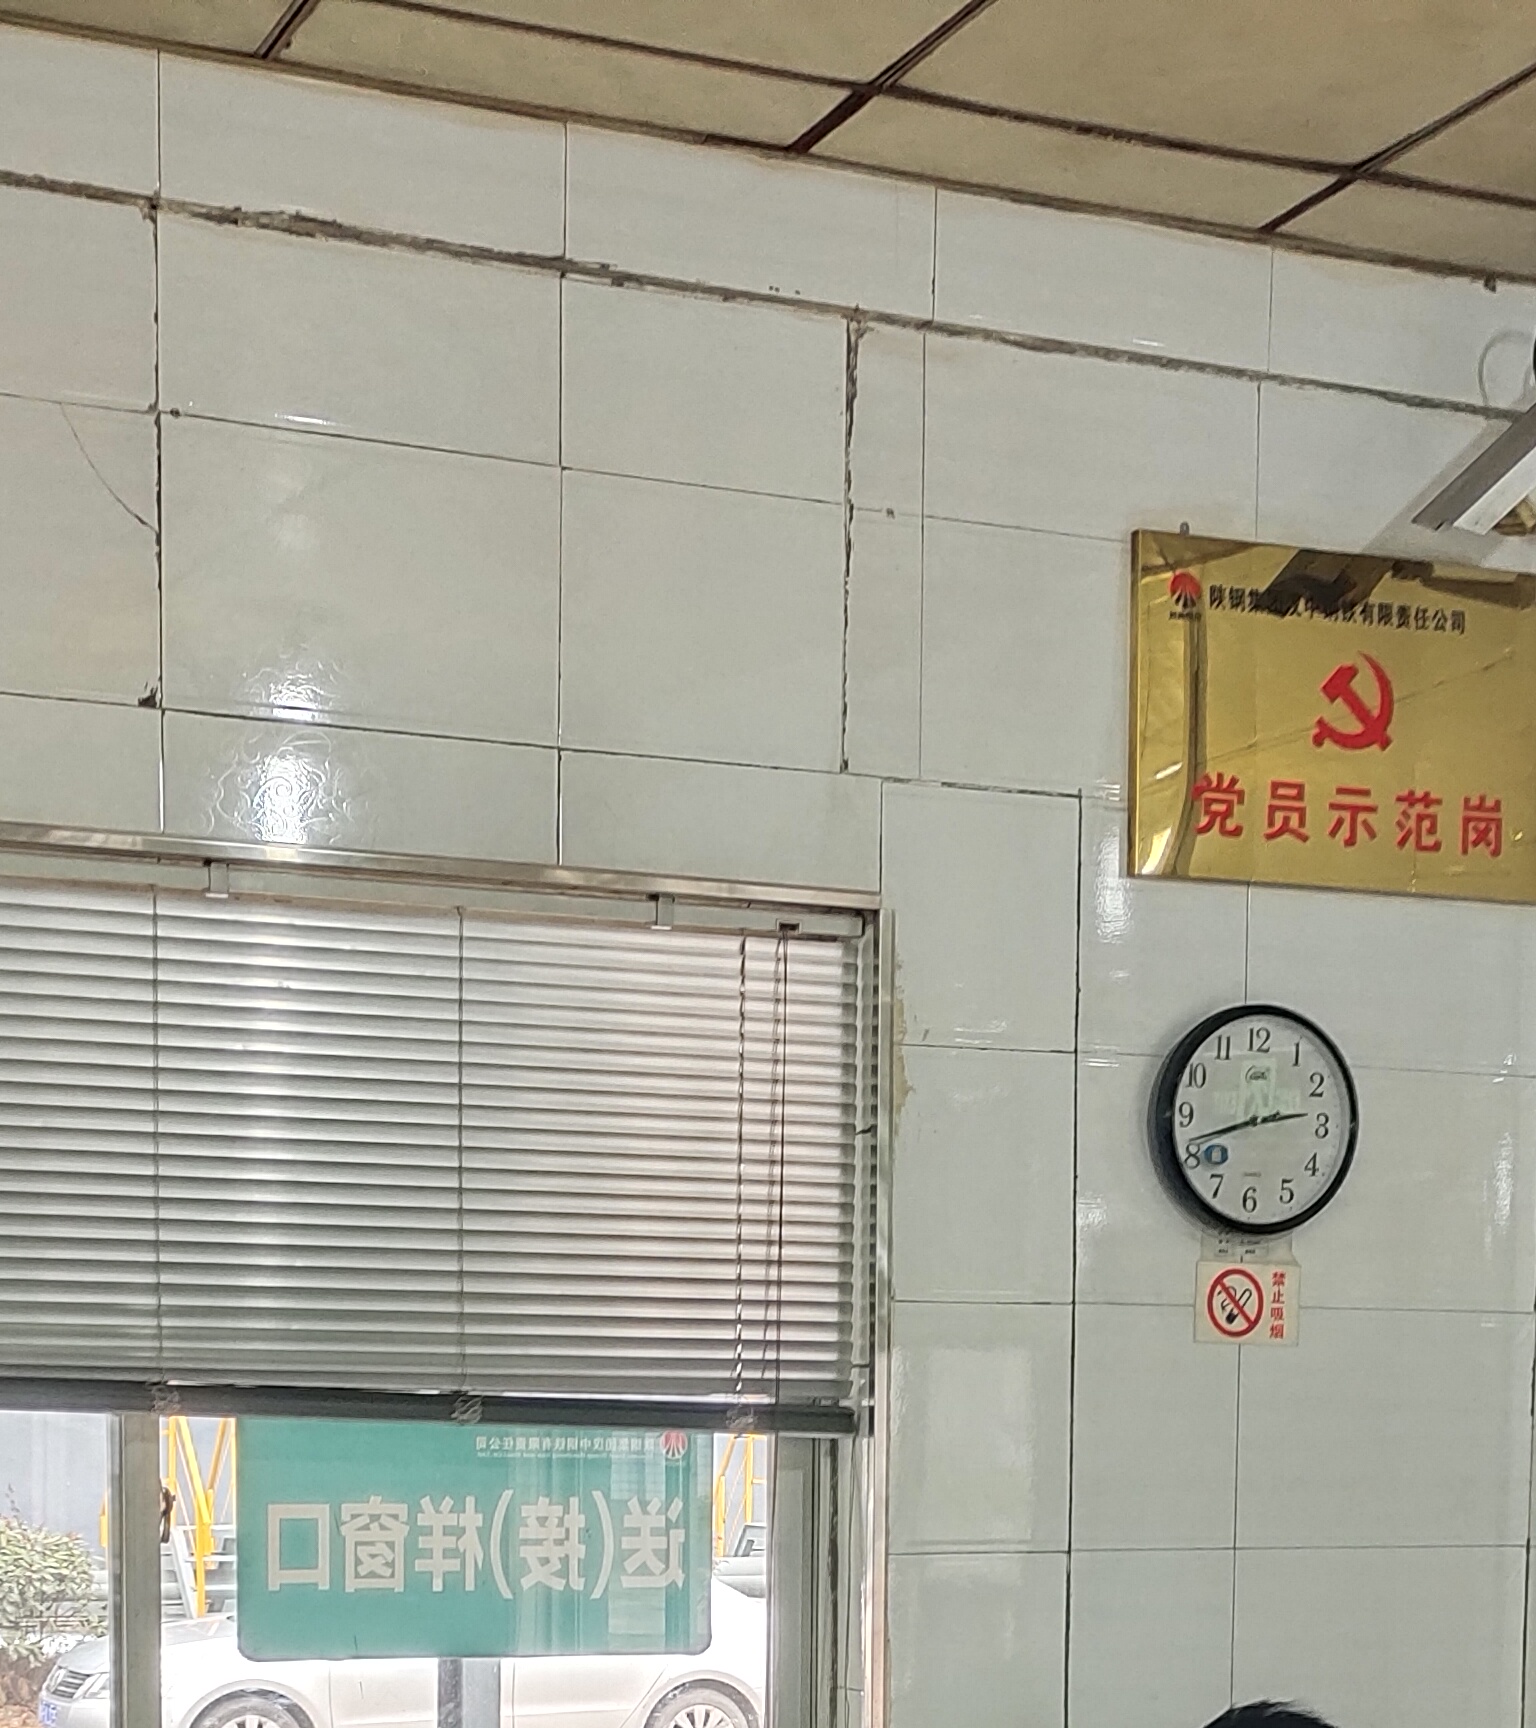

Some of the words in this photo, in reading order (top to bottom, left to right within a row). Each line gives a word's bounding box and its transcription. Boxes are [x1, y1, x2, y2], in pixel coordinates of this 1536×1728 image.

[1191, 771, 1504, 858] 党员示范岗
[1214, 1034, 1231, 1061] 11
[1247, 1027, 1271, 1054] 12
[1292, 1041, 1302, 1067] 1
[1185, 1061, 1207, 1089] 10
[1309, 1072, 1325, 1098] 2
[1178, 1101, 1195, 1128] 9
[1314, 1112, 1330, 1139] 3
[1183, 1142, 1201, 1170] 8
[1304, 1152, 1320, 1177] 4
[1209, 1173, 1224, 1199] 7
[1242, 1186, 1257, 1213] 6
[1279, 1178, 1295, 1205] 5
[1269, 1270, 1287, 1340] 禁止吸烟
